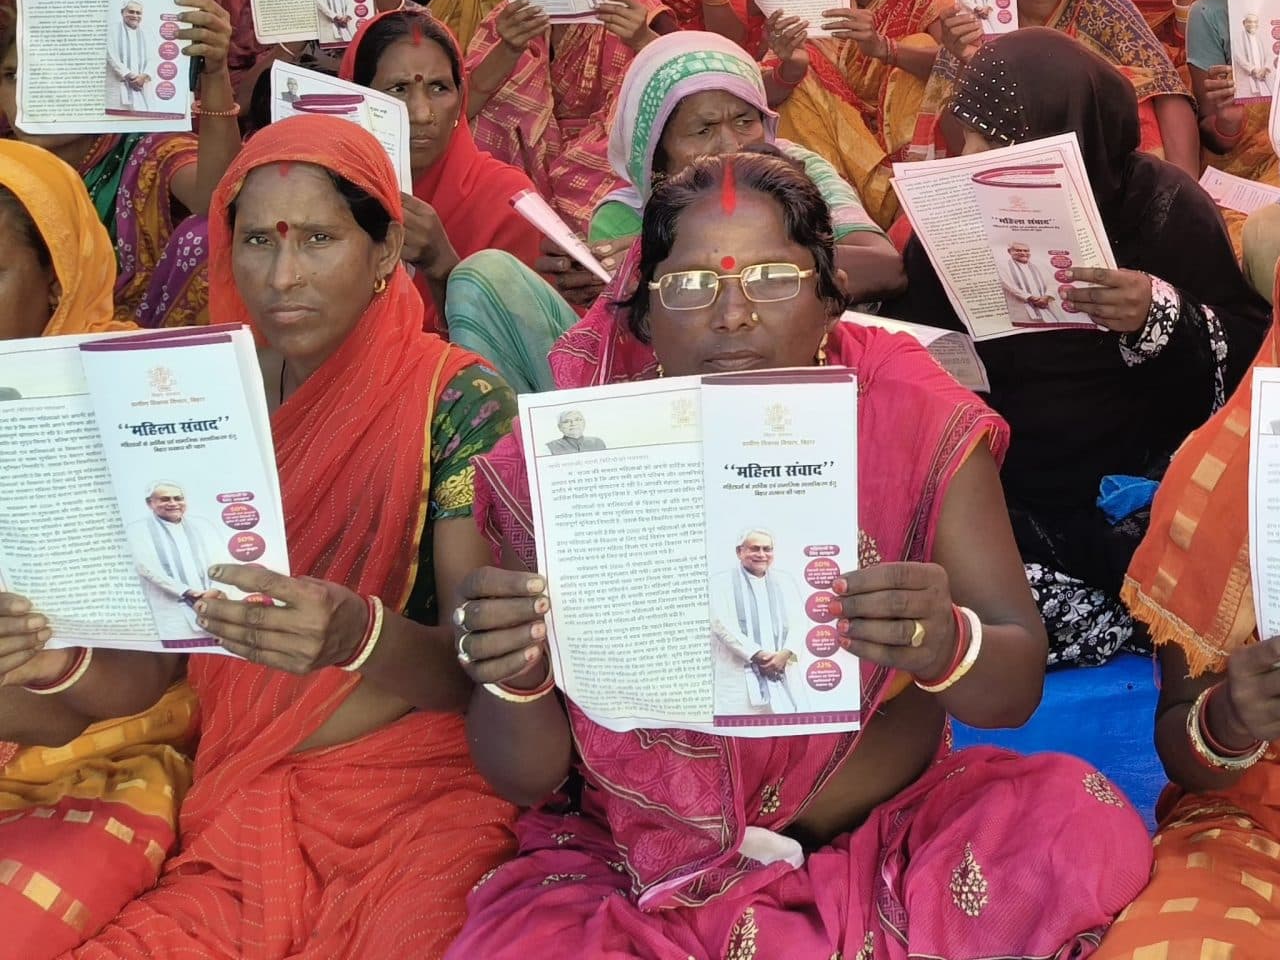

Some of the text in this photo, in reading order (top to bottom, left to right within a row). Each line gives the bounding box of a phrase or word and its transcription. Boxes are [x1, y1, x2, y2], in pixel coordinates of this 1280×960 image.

[119, 416, 229, 436] “महिला संवाद”
[724, 461, 834, 478] “महिला संवाद”
